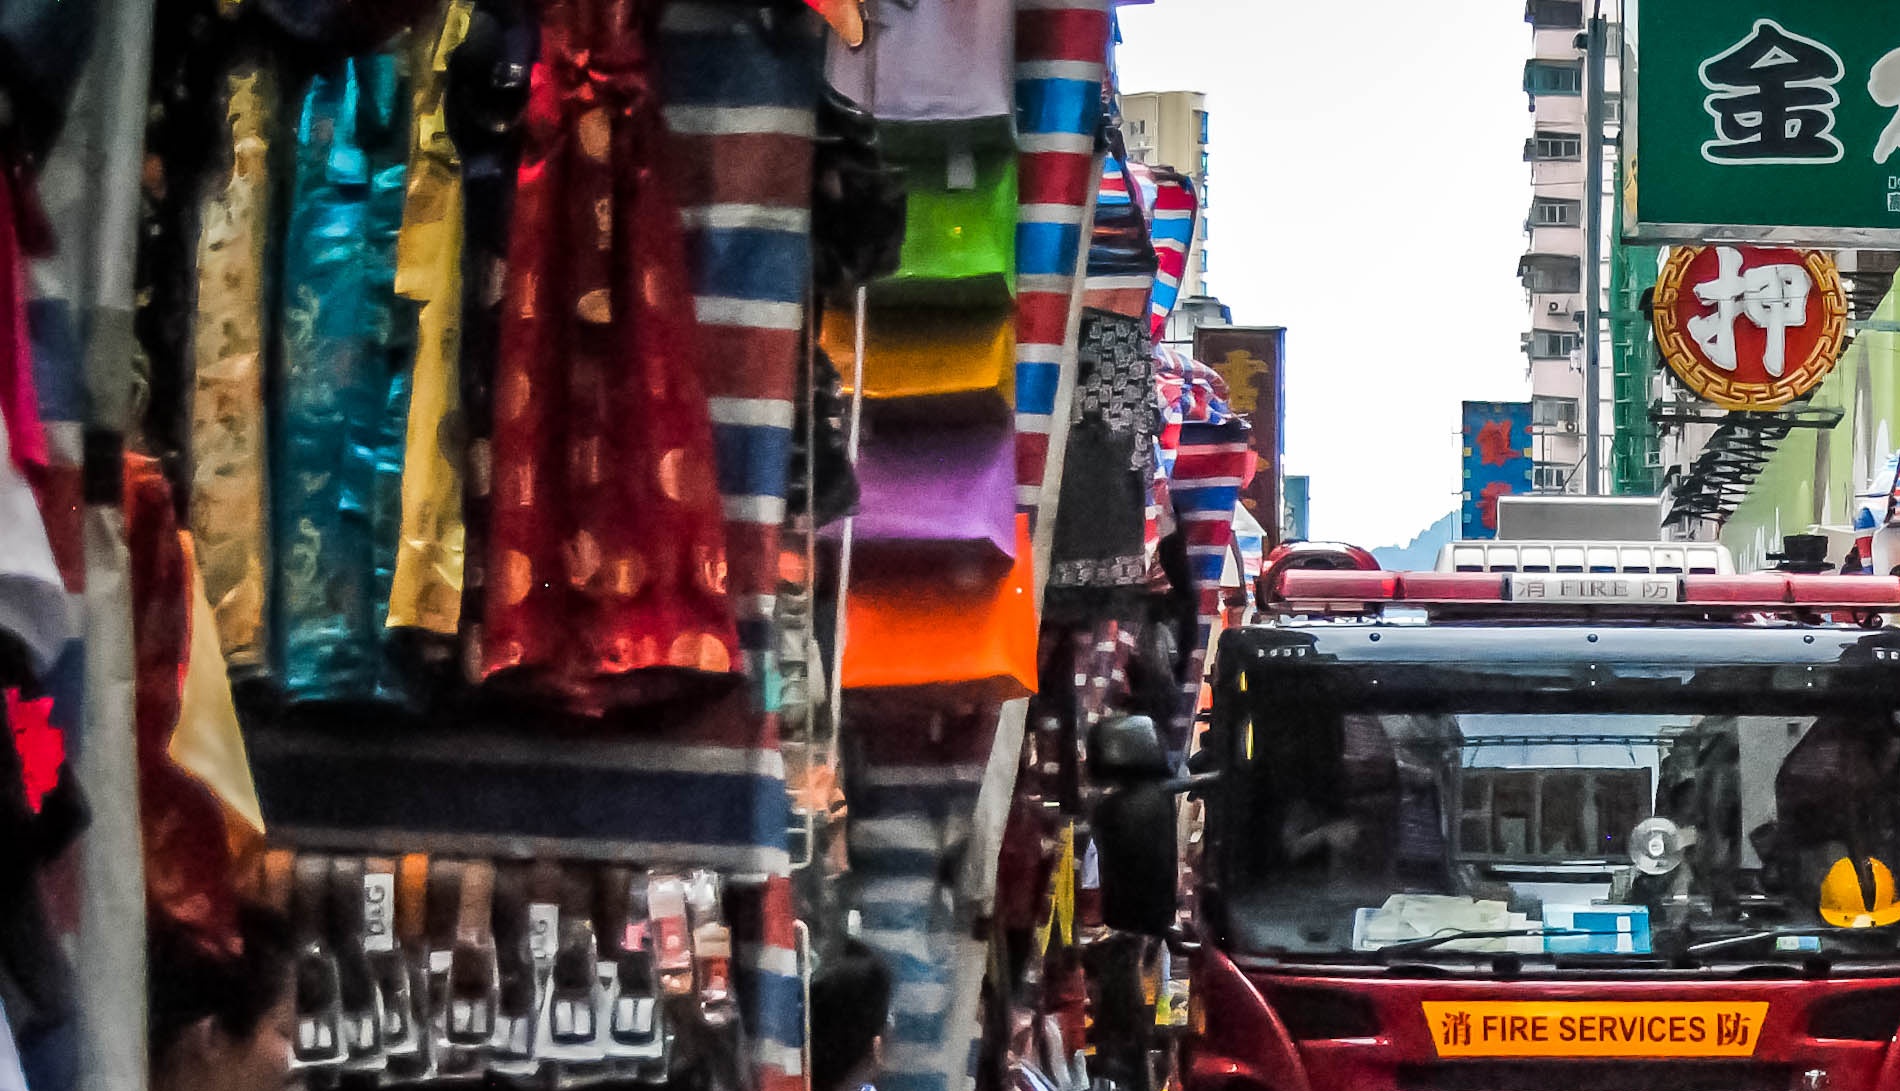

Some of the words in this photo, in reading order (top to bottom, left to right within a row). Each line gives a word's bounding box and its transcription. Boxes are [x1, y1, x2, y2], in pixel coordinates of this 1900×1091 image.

[1687, 246, 1812, 377] 押
[1560, 579, 1628, 597] FIRE
[1442, 1012, 1471, 1046] 消
[1483, 1016, 1548, 1042] FIRE
[1559, 1016, 1706, 1042] SERVICES
[1717, 1013, 1751, 1046] 防
